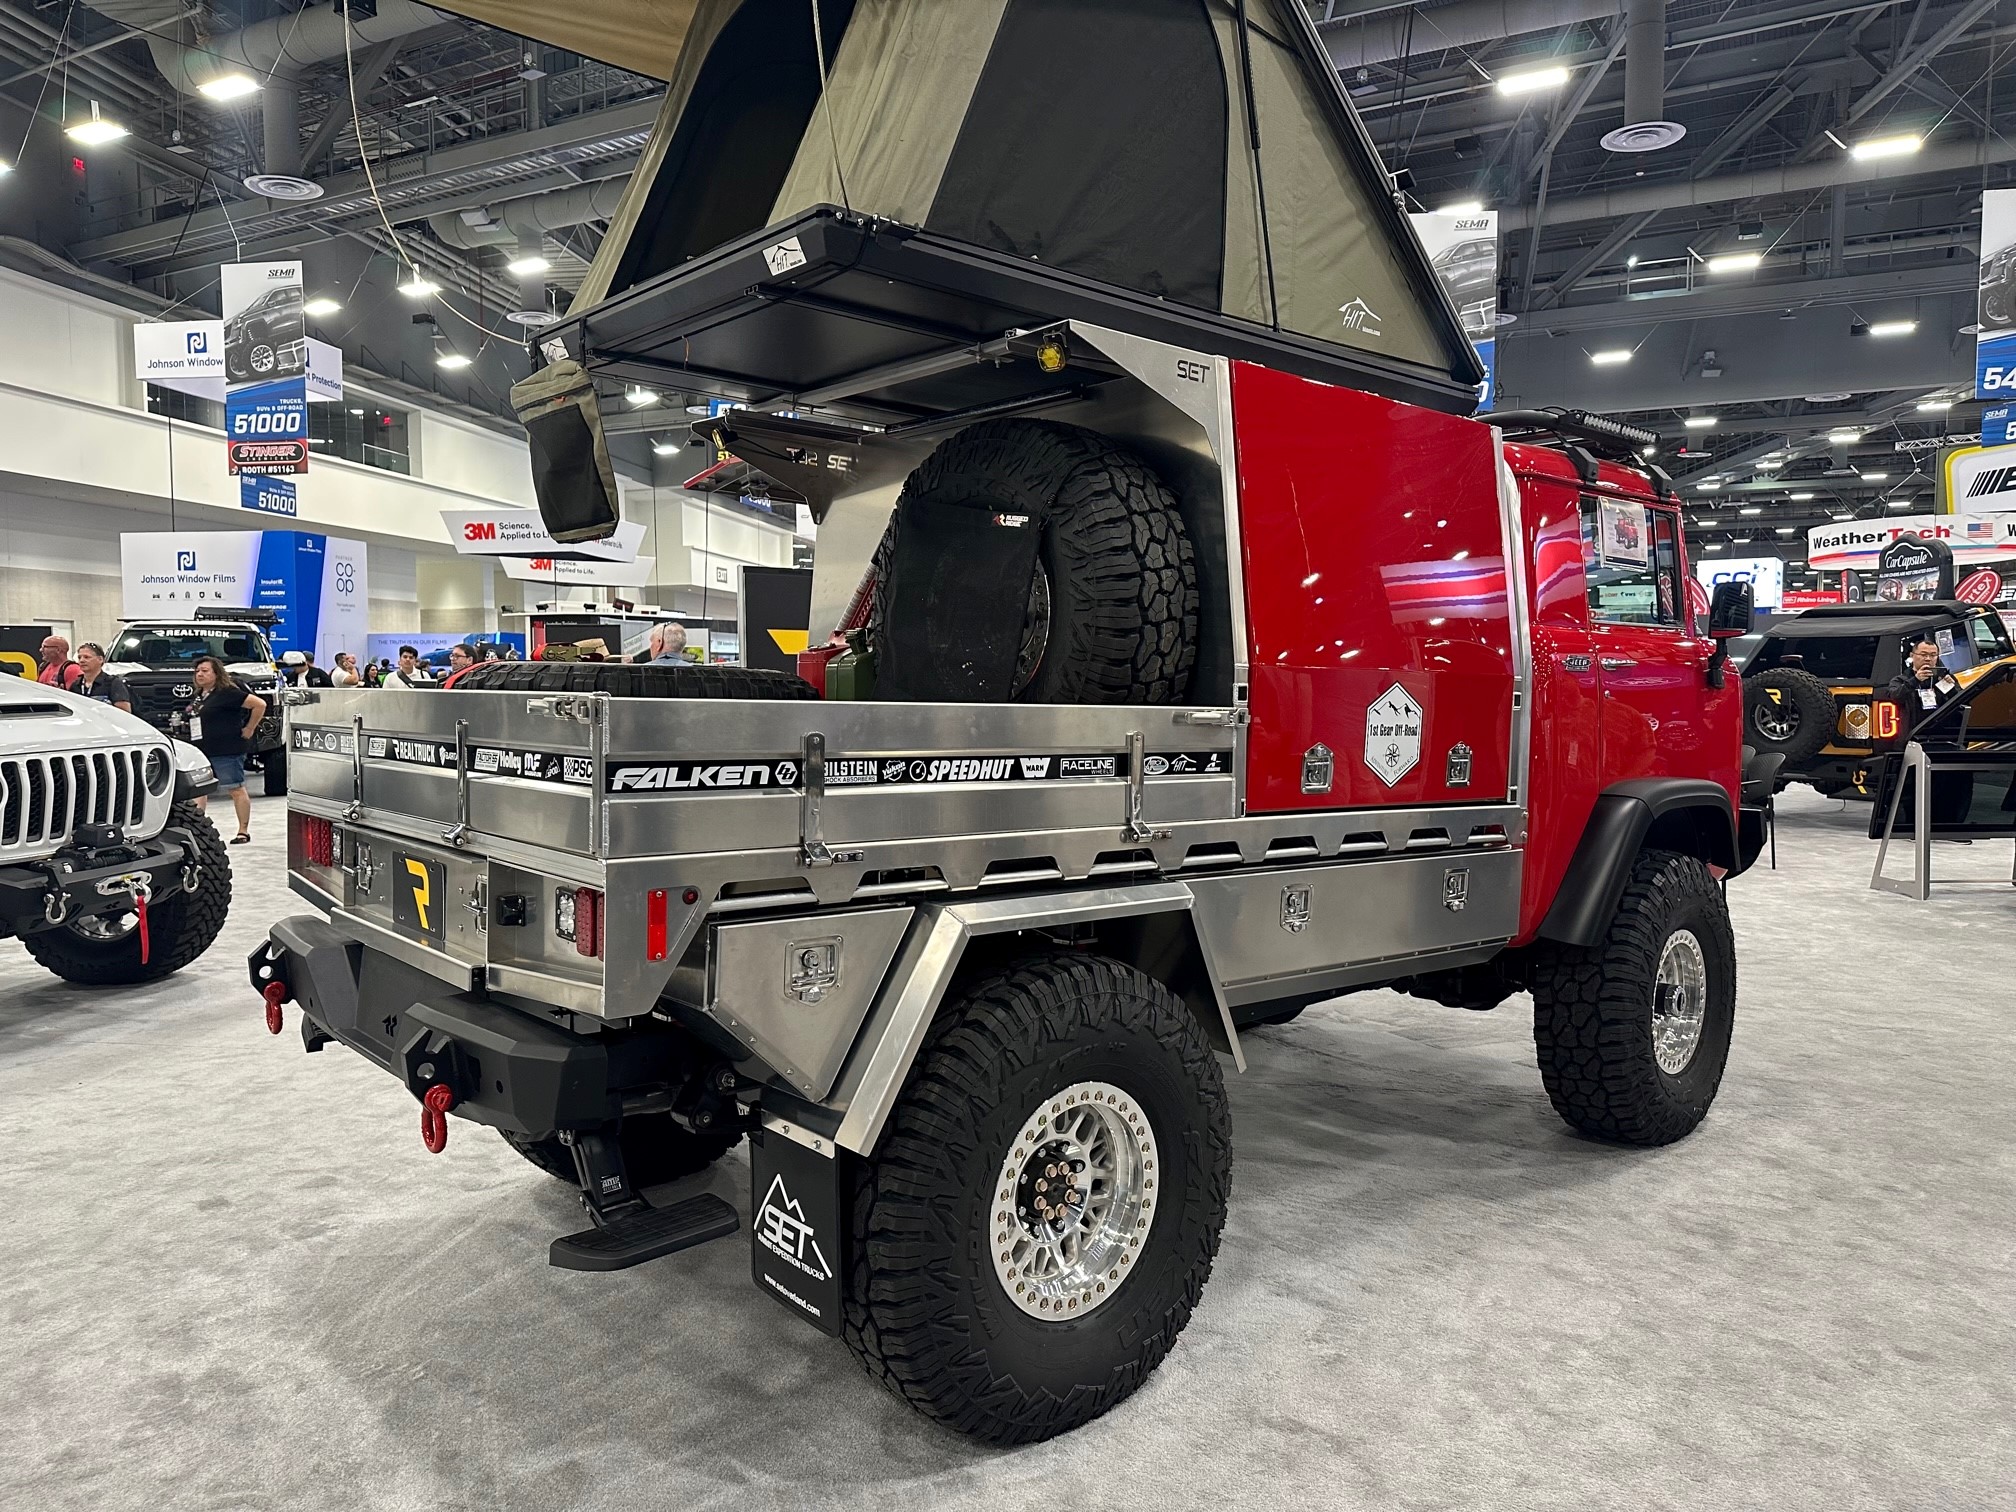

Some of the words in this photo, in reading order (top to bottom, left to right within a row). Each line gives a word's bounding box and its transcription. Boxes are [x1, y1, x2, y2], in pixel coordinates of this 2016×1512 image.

[1455, 219, 1489, 228] SEMA
[267, 268, 295, 277] SEMA
[147, 358, 185, 369] Johnson
[187, 357, 223, 366] Window
[1177, 359, 1211, 384] SET
[311, 373, 342, 391] Protection
[234, 412, 301, 434] 51000
[1984, 409, 2008, 419] SEMA
[239, 445, 297, 457] STINGER
[242, 466, 266, 474] BOOTH
[268, 465, 295, 473] #51163
[258, 491, 295, 513] 51000
[464, 522, 496, 541] 3M
[499, 522, 533, 530] Science.
[500, 531, 531, 540] Applied
[1813, 525, 1950, 550] WeatherTch
[529, 557, 552, 571] 3M
[1885, 552, 1928, 570] CarCapsule
[141, 575, 175, 584] Johnson
[177, 574, 210, 583] Window
[213, 574, 236, 583] Films
[166, 629, 230, 639] REALTRUCK
[1370, 724, 1378, 736] 1st
[1380, 724, 1393, 736] Gear
[1395, 724, 1418, 737] Off-Road
[400, 742, 436, 764] REALTRUCK
[500, 750, 522, 775] Holley
[573, 759, 593, 778] PSC
[824, 760, 878, 777] BILSTEIN
[882, 761, 906, 779] Yukon
[926, 759, 1015, 782] SPEEDHUT
[1025, 764, 1044, 772] WARN
[1062, 759, 1113, 771] RACELINE
[610, 766, 770, 790] FALKEN
[764, 1203, 814, 1260] SET
[757, 1232, 773, 1251] SUMMIT
[772, 1244, 800, 1269] EXPEDITION
[800, 1262, 825, 1281] TRUCKS
[764, 1273, 821, 1318] www.setoverland.com
